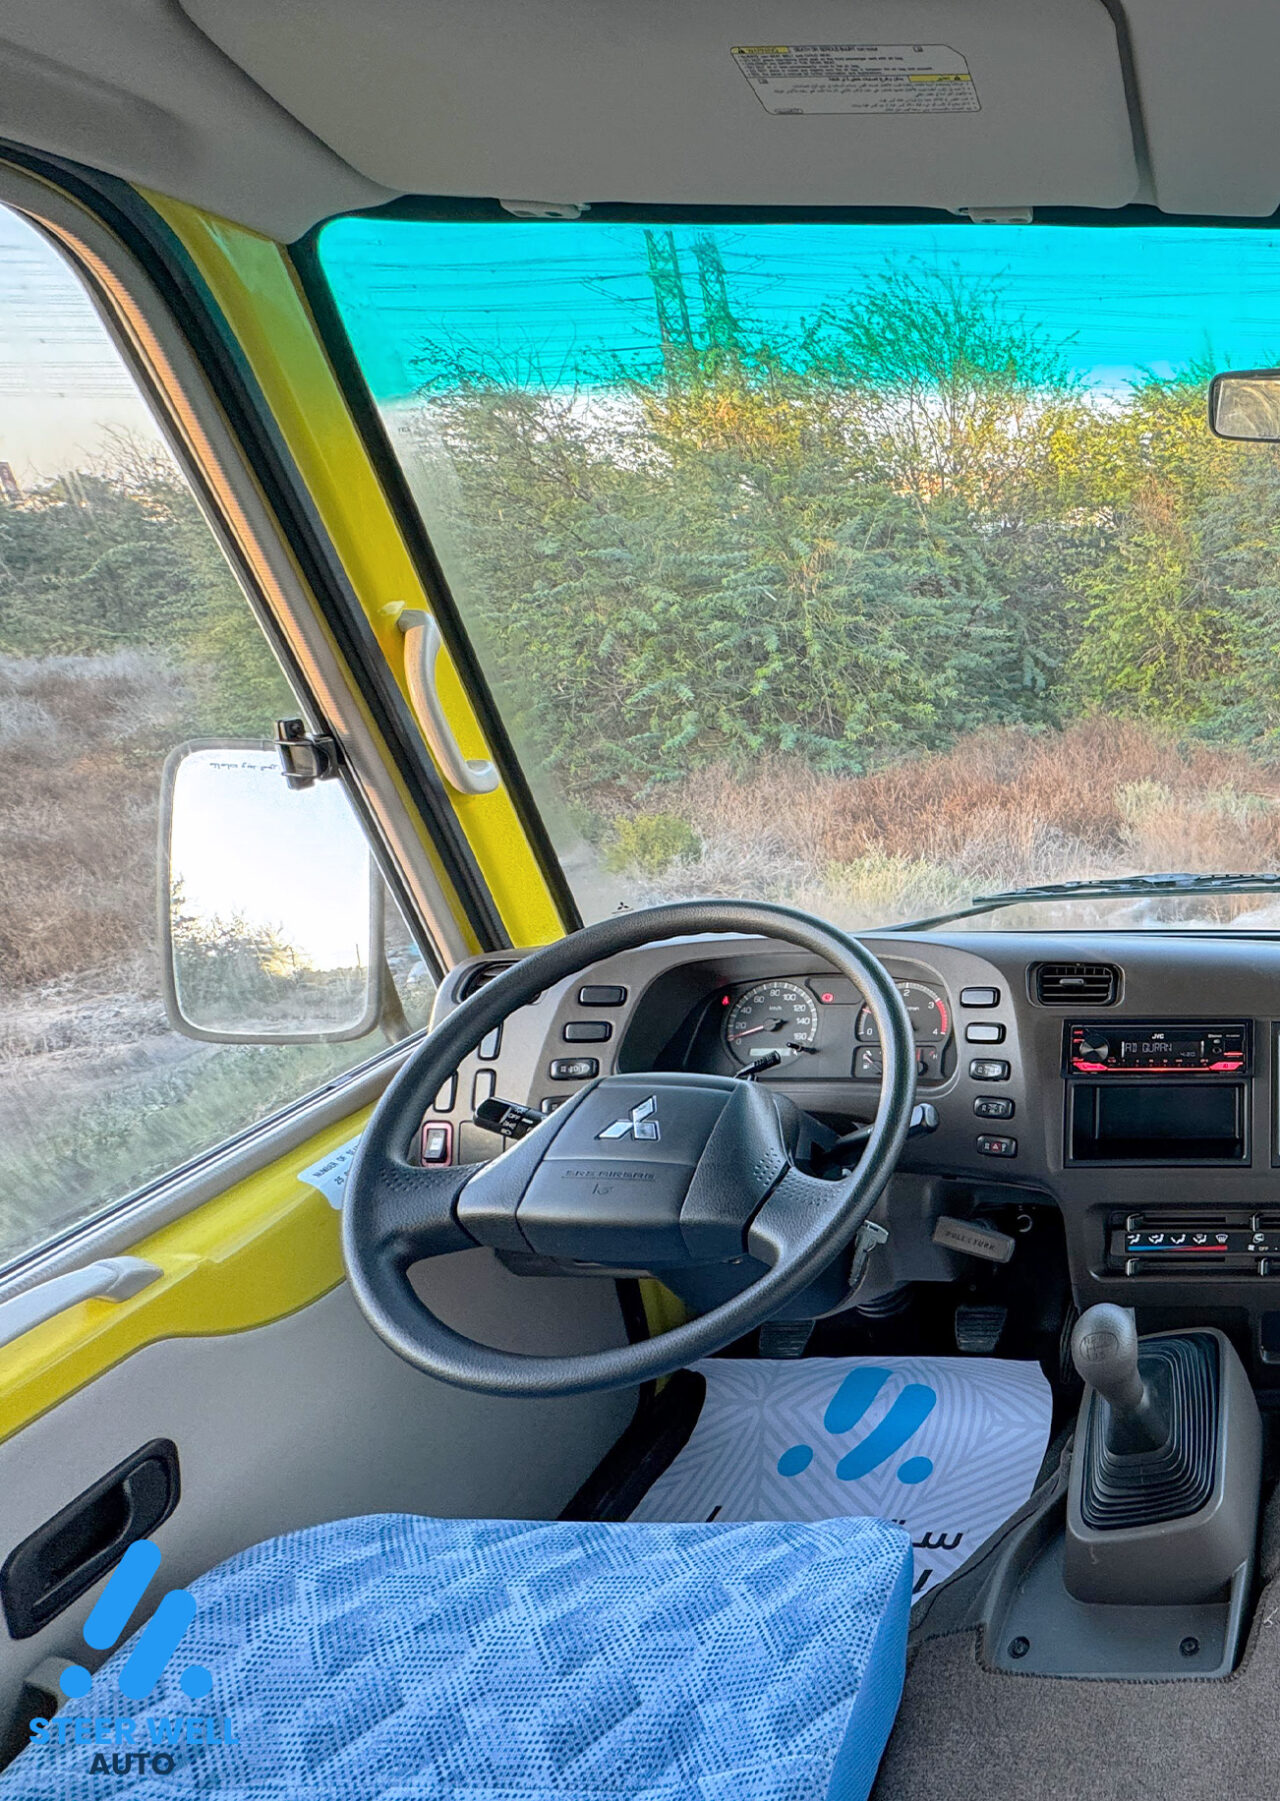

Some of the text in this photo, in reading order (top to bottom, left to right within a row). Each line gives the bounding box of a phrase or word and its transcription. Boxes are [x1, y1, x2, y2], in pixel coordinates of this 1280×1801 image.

[769, 989, 780, 997] 80
[782, 993, 797, 1001] 100
[903, 989, 910, 997] 2
[753, 995, 765, 1004] 60
[793, 1004, 806, 1012] 120
[927, 1001, 935, 1009] 3
[740, 1006, 752, 1014] 40
[735, 1021, 747, 1029] 20
[796, 1017, 811, 1025] 140
[866, 1027, 873, 1035] 0
[932, 1027, 938, 1035] 4
[507, 1112, 521, 1120] OFF
[312, 1161, 339, 1178] NUMBER
[334, 1175, 345, 1185] 25
